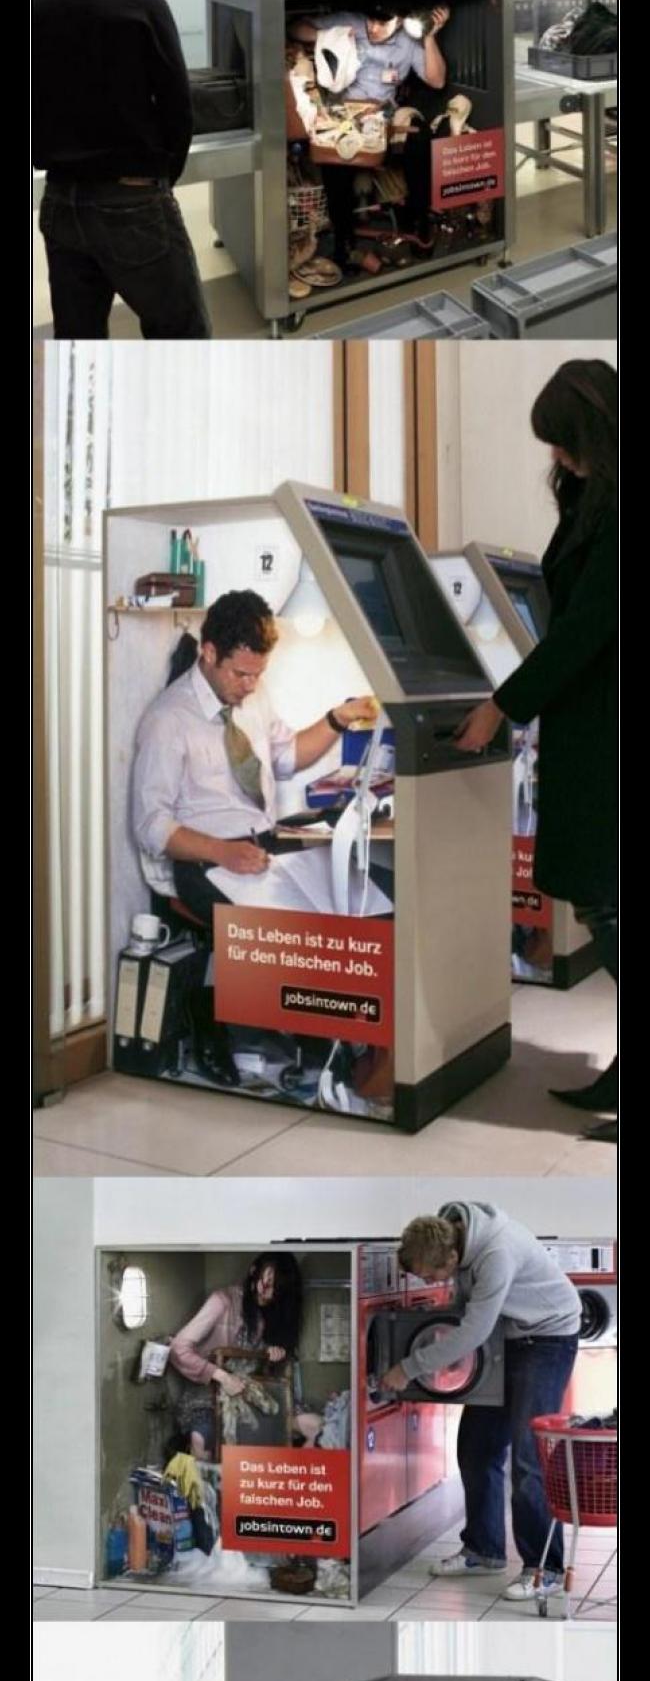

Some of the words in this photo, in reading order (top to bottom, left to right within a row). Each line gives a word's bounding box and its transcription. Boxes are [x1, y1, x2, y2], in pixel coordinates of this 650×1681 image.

[260, 553, 274, 572] 12
[228, 923, 253, 940] Das
[259, 927, 300, 944] Leben
[305, 932, 322, 948] ist
[327, 938, 344, 949] zu
[348, 937, 382, 954] kurz
[228, 947, 247, 960] für
[251, 949, 276, 964] den
[280, 952, 341, 972] falschen
[345, 960, 378, 976] Job.
[240, 1461, 263, 1472] Das
[268, 1462, 306, 1474] Leben
[311, 1464, 325, 1475] ist
[240, 1479, 254, 1488] zu
[257, 1478, 285, 1489] kurz
[288, 1479, 305, 1490] für
[309, 1480, 333, 1492] den
[240, 1493, 293, 1506] falschen
[297, 1496, 324, 1508] Job.
